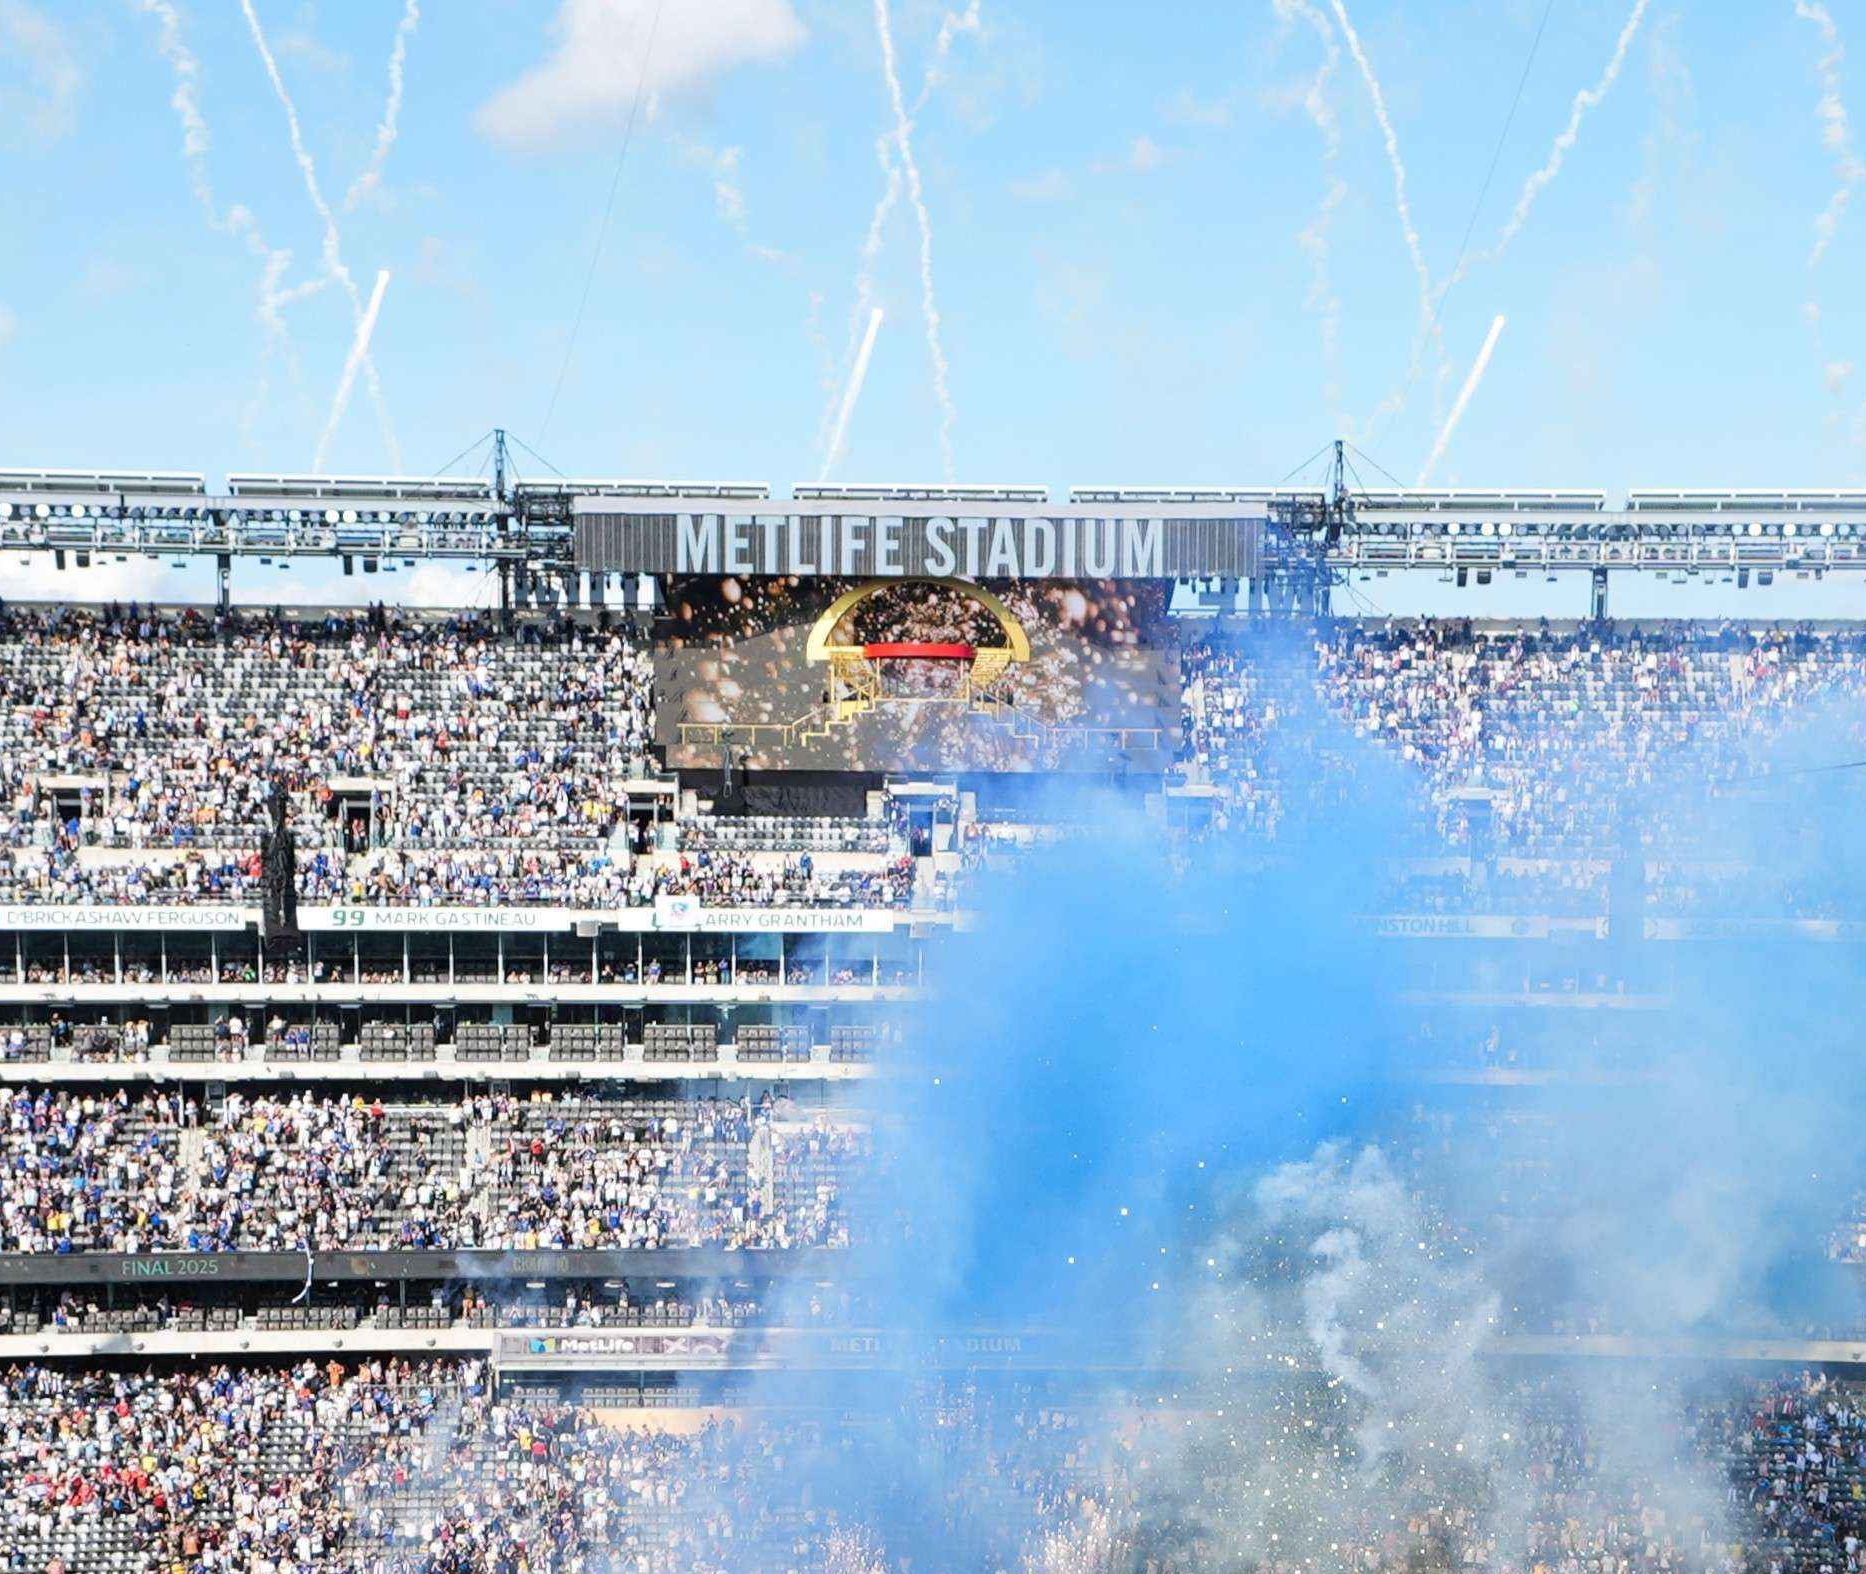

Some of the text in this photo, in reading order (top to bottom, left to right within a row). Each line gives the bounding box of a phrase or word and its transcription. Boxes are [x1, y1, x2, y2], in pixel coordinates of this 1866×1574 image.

[677, 512, 1165, 578] METLIFE STADIUM
[146, 911, 240, 926] FERGUSON
[332, 910, 537, 926] 99 MARK GASTINEAU
[705, 913, 864, 927] ARRY GRANTHAM
[121, 1258, 219, 1276] FINAL 2025
[561, 1339, 634, 1352] MetLife
